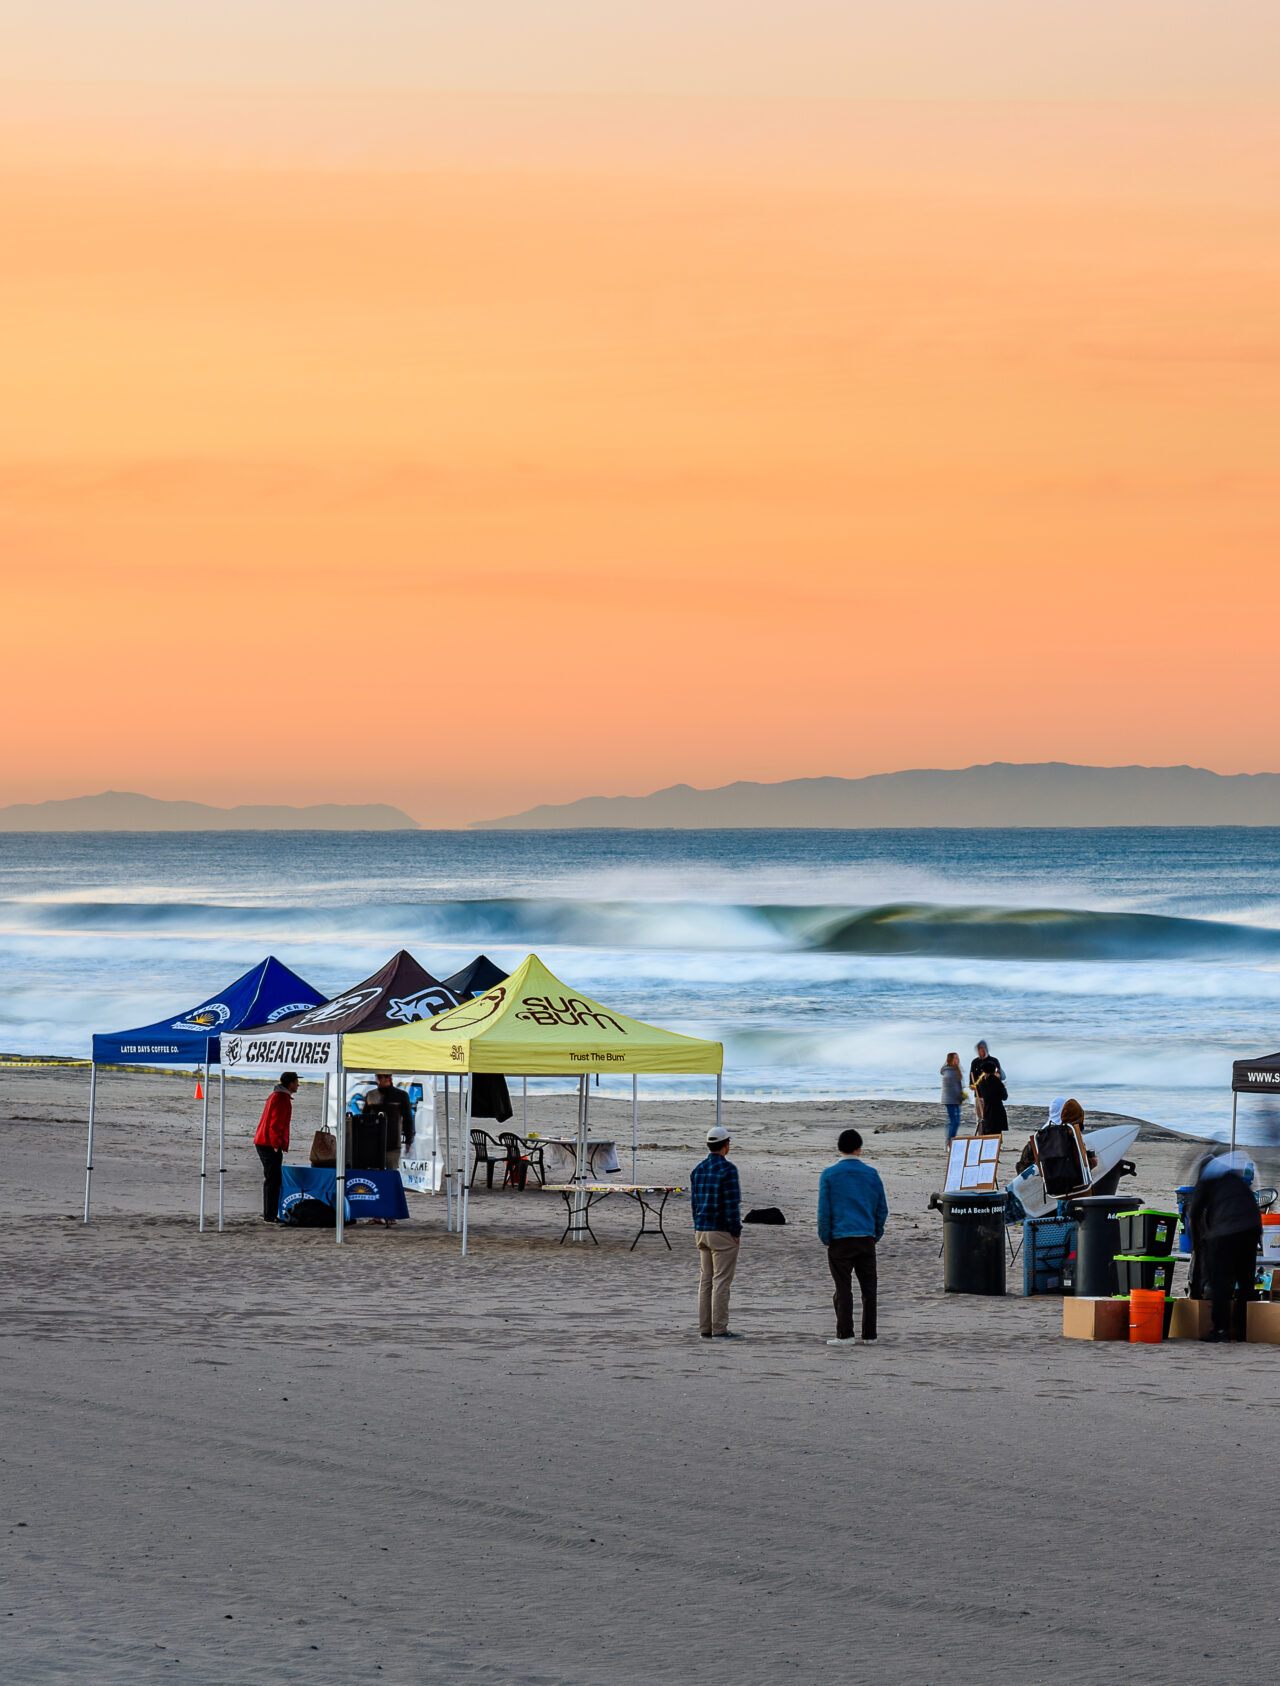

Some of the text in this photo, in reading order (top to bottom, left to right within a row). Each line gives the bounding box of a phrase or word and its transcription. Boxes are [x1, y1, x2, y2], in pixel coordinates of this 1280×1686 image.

[120, 1045, 179, 1054] LATER DAYS COFFEE CO.
[245, 1041, 331, 1064] CREATURES
[569, 1052, 590, 1061] Trust
[590, 1052, 605, 1061] The
[951, 1207, 967, 1216] Adopt
